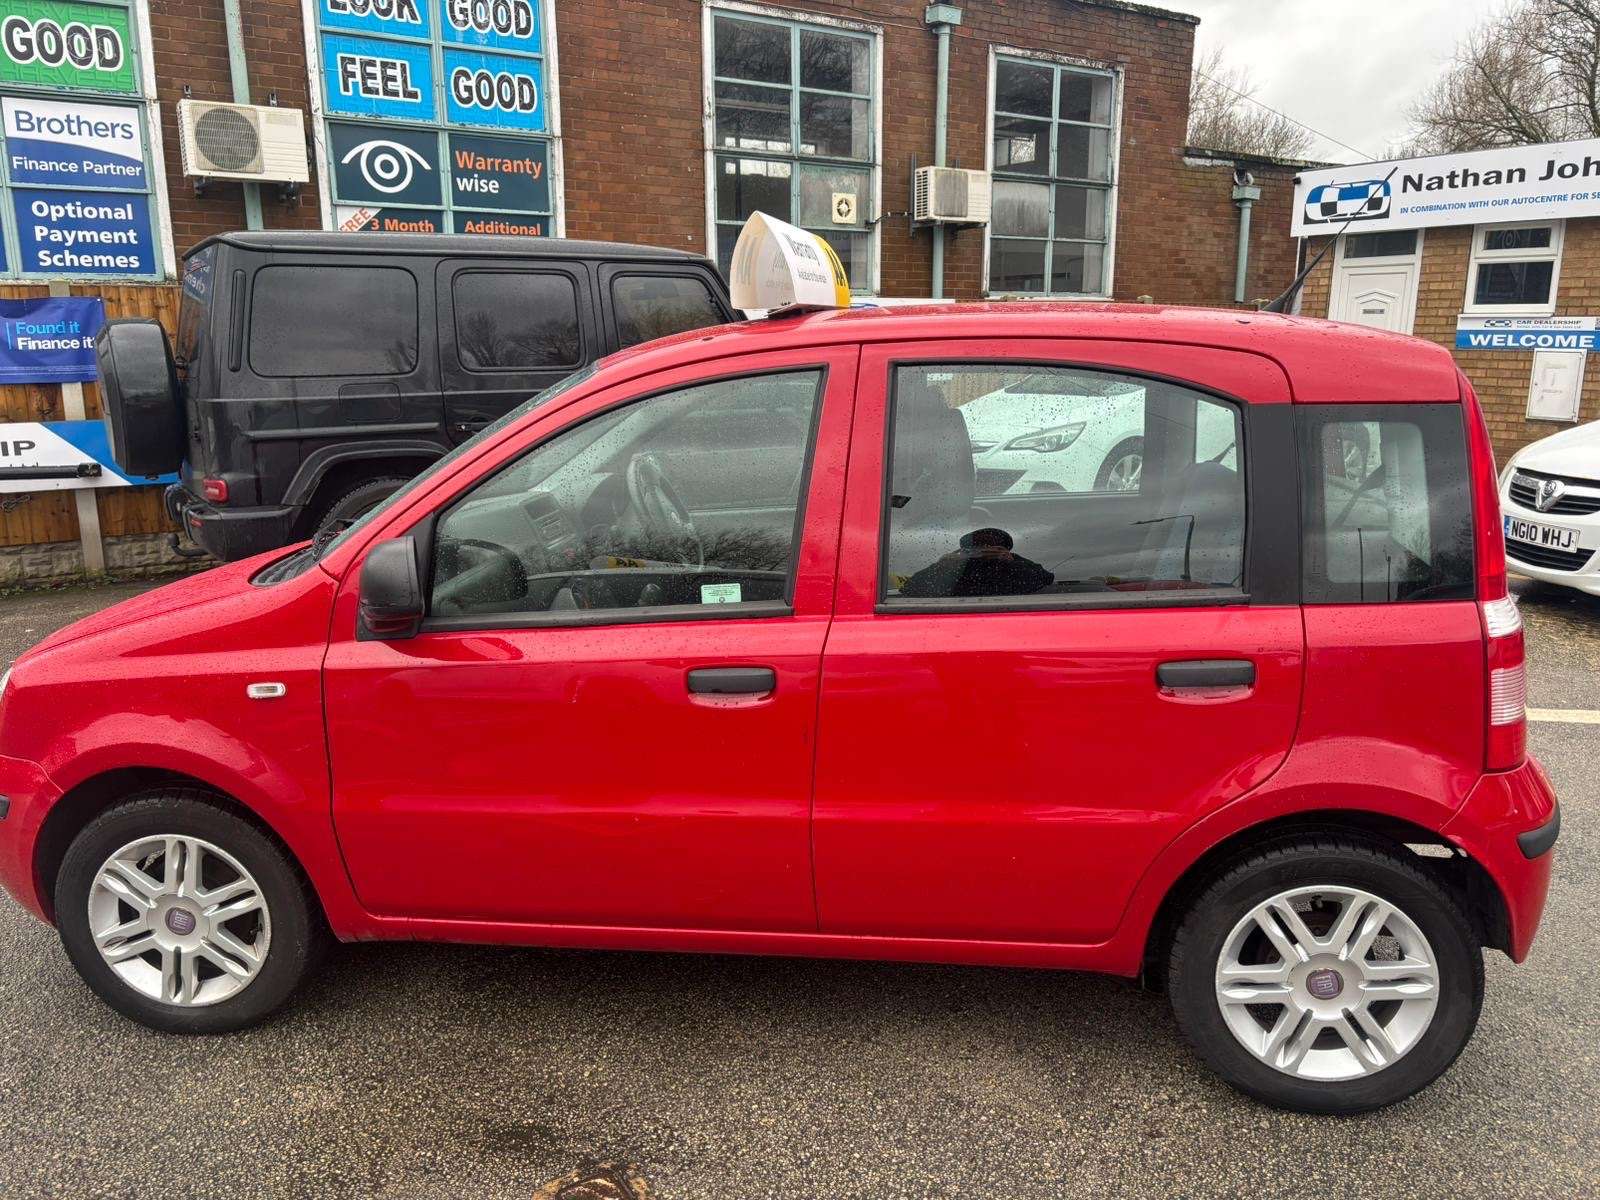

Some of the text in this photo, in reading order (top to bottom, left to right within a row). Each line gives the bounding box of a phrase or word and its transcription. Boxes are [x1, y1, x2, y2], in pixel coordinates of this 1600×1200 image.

[448, 0, 534, 38] GOOD
[2, 16, 123, 70] GOOD
[338, 55, 421, 102] FEEL
[452, 67, 538, 113] GOOD
[14, 110, 134, 140] Brothers
[12, 156, 142, 177] Finance Partner
[455, 151, 543, 179] Warranty
[1402, 156, 1600, 193] Nathan Joh
[456, 174, 499, 193] wise
[31, 200, 133, 222] Optional
[1410, 202, 1466, 213] COMBINATION
[1468, 200, 1489, 208] WITH
[1491, 198, 1509, 207] OUR
[1511, 193, 1569, 205] AUTOCENTRE
[1571, 192, 1589, 200] FOR
[35, 225, 138, 247] Payment
[371, 218, 434, 232] 3 Month
[465, 220, 541, 236] Additional
[38, 250, 140, 269] Schemes
[16, 320, 80, 335] Found it
[17, 336, 80, 350] Finance
[1468, 332, 1595, 348] WELCOME
[1511, 520, 1573, 548] NG10 WHJ
